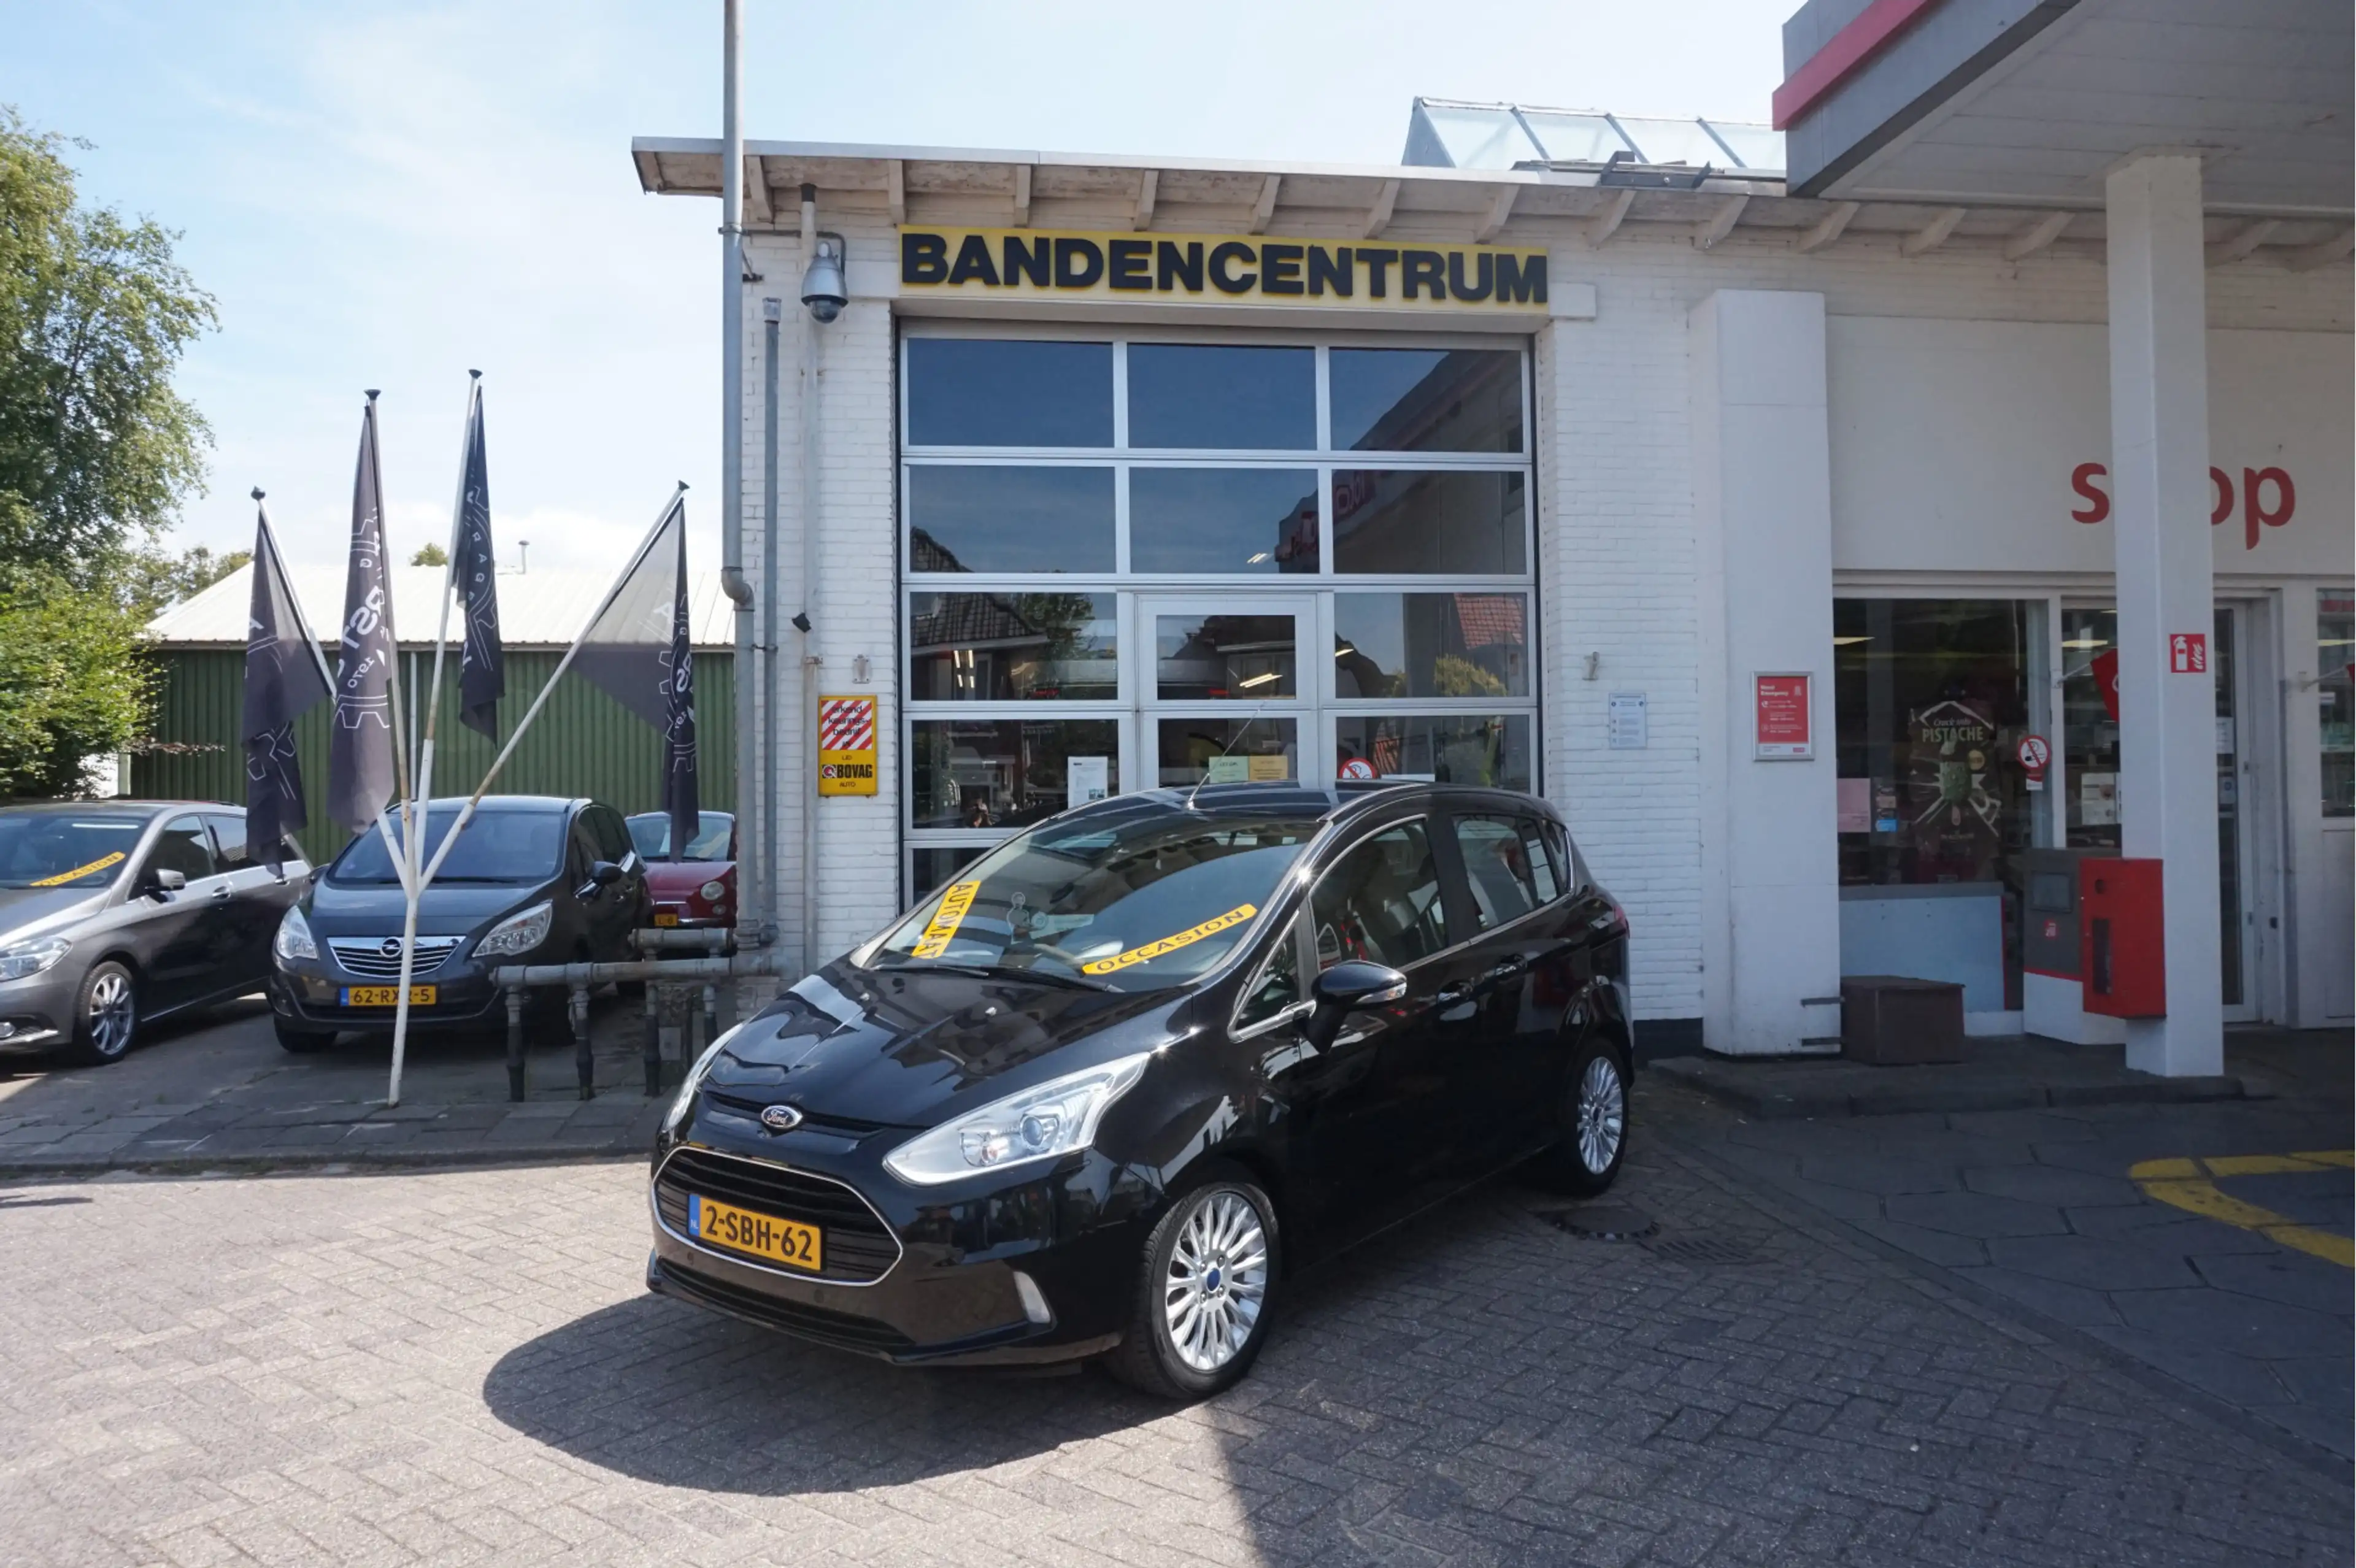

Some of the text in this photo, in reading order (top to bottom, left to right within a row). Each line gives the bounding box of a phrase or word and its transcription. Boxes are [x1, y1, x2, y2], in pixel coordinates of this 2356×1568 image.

[902, 233, 1548, 304] BANDENCENTRUM
[2071, 463, 2296, 550] sp
[1922, 726, 1984, 742] PISTACHE
[837, 764, 872, 778] BOVAG
[917, 884, 972, 958] AUTOMAAT
[1097, 910, 1244, 972] OCCASION
[767, 1109, 789, 1124] Ford
[706, 1205, 812, 1262] 2-SBH-62
